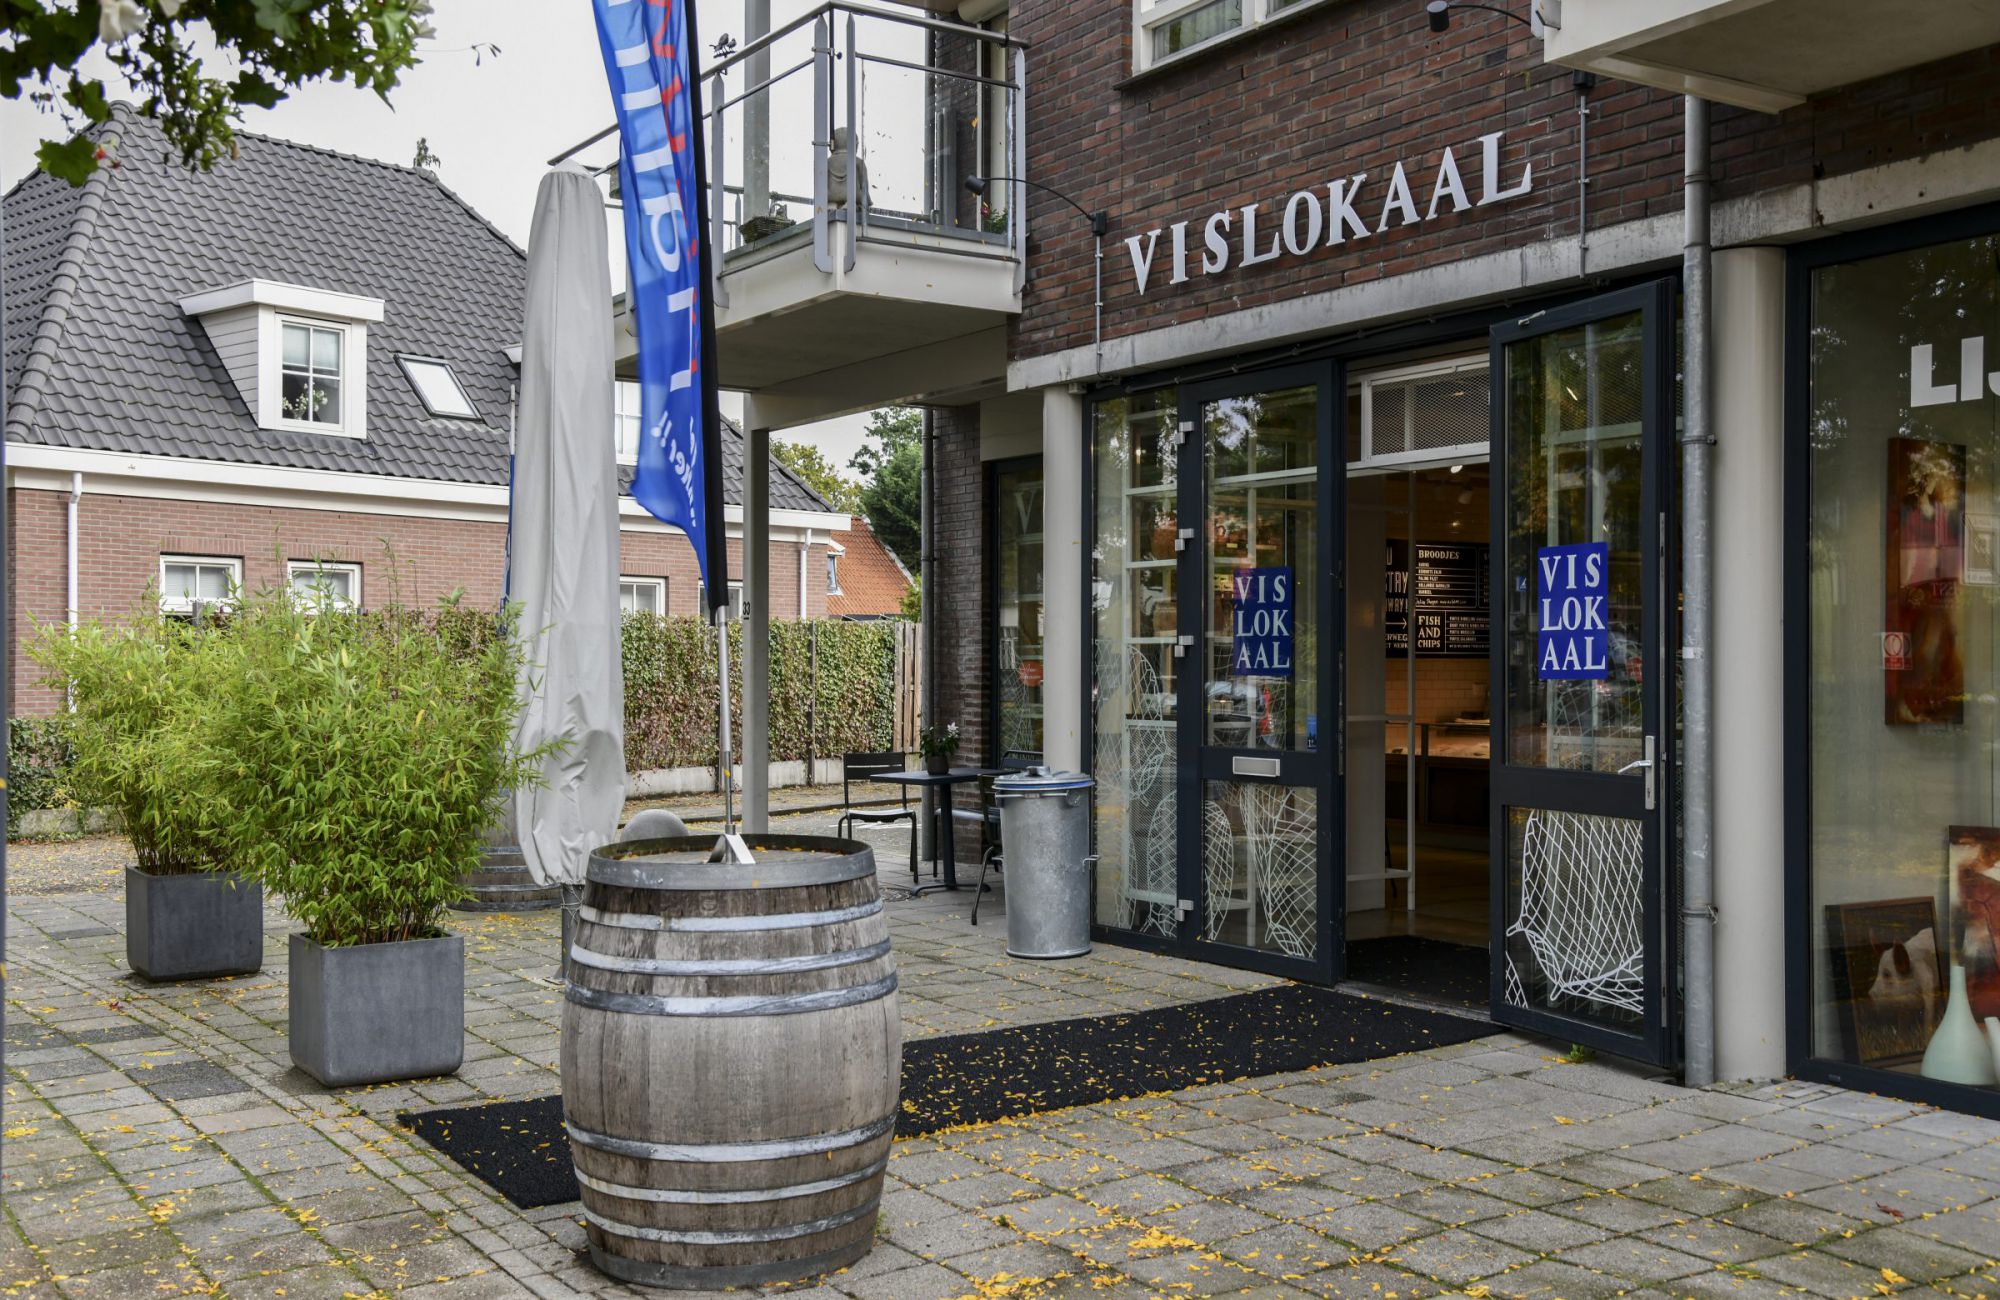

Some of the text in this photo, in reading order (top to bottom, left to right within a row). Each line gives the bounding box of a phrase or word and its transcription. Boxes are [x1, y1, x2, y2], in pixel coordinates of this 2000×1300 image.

[1124, 130, 1532, 296] VISLOKAAL
[1418, 549, 1460, 560] BROODJES
[1385, 571, 1409, 594] TAY
[1540, 553, 1601, 592] VIS
[1235, 575, 1287, 606] VIS
[1236, 609, 1290, 637] LOK
[1418, 615, 1441, 626] FISH
[1541, 596, 1606, 631] LOK
[1417, 639, 1441, 649] CHIPS
[1418, 627, 1441, 638] AND
[1236, 641, 1290, 669] AAL
[1541, 637, 1606, 671] AAL
